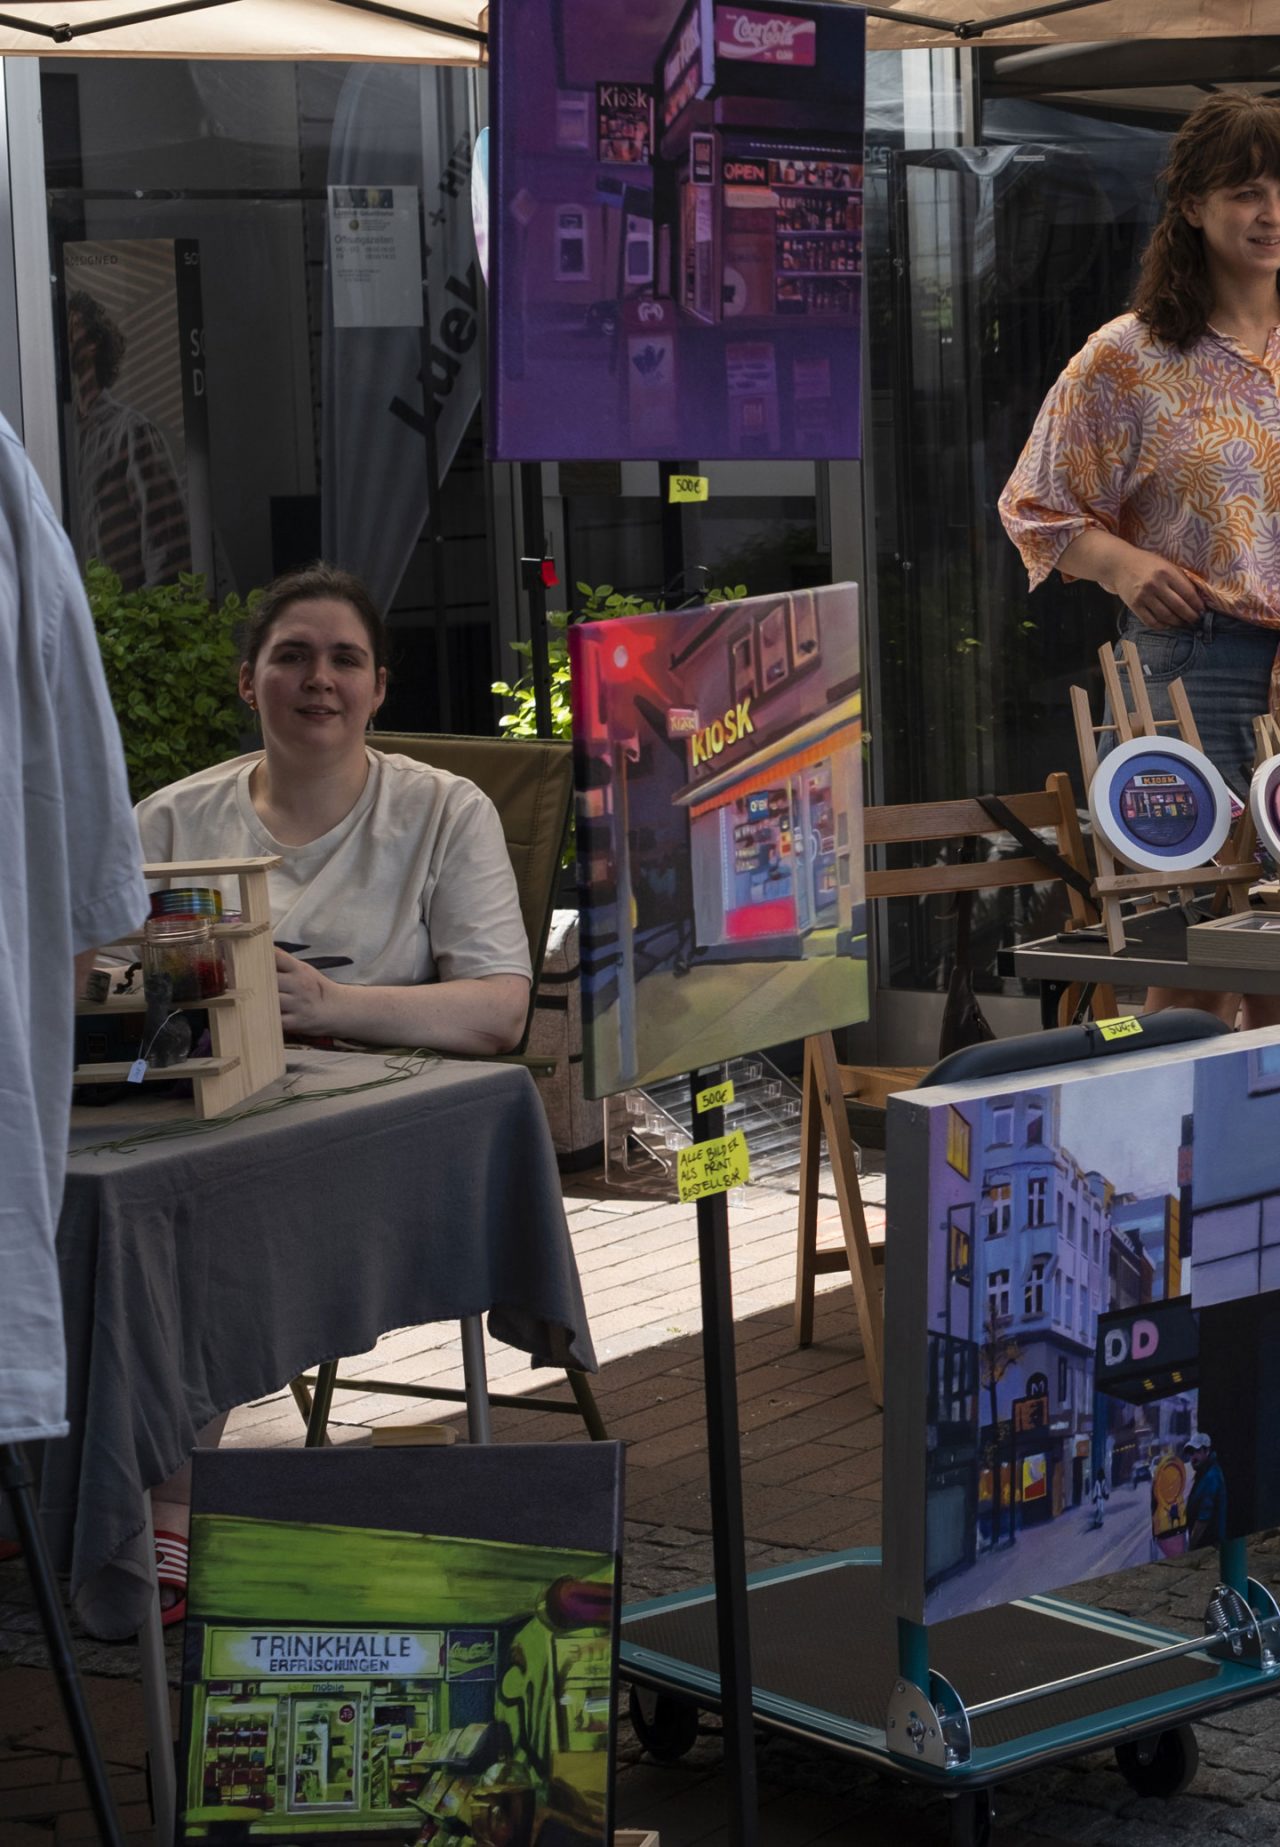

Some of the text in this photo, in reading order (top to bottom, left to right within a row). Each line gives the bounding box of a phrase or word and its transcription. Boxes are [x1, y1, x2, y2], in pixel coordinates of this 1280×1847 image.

[600, 86, 648, 108] Kiosk
[724, 162, 765, 180] OPEN
[691, 697, 754, 767] KIOSK
[702, 1089, 729, 1108] 500€
[680, 1138, 740, 1167] ALLE BILDER
[681, 1158, 732, 1181] ALS PRINT
[251, 1635, 411, 1658] TRINKHALLE
[269, 1658, 390, 1673] ERFRISCHUNGEN
